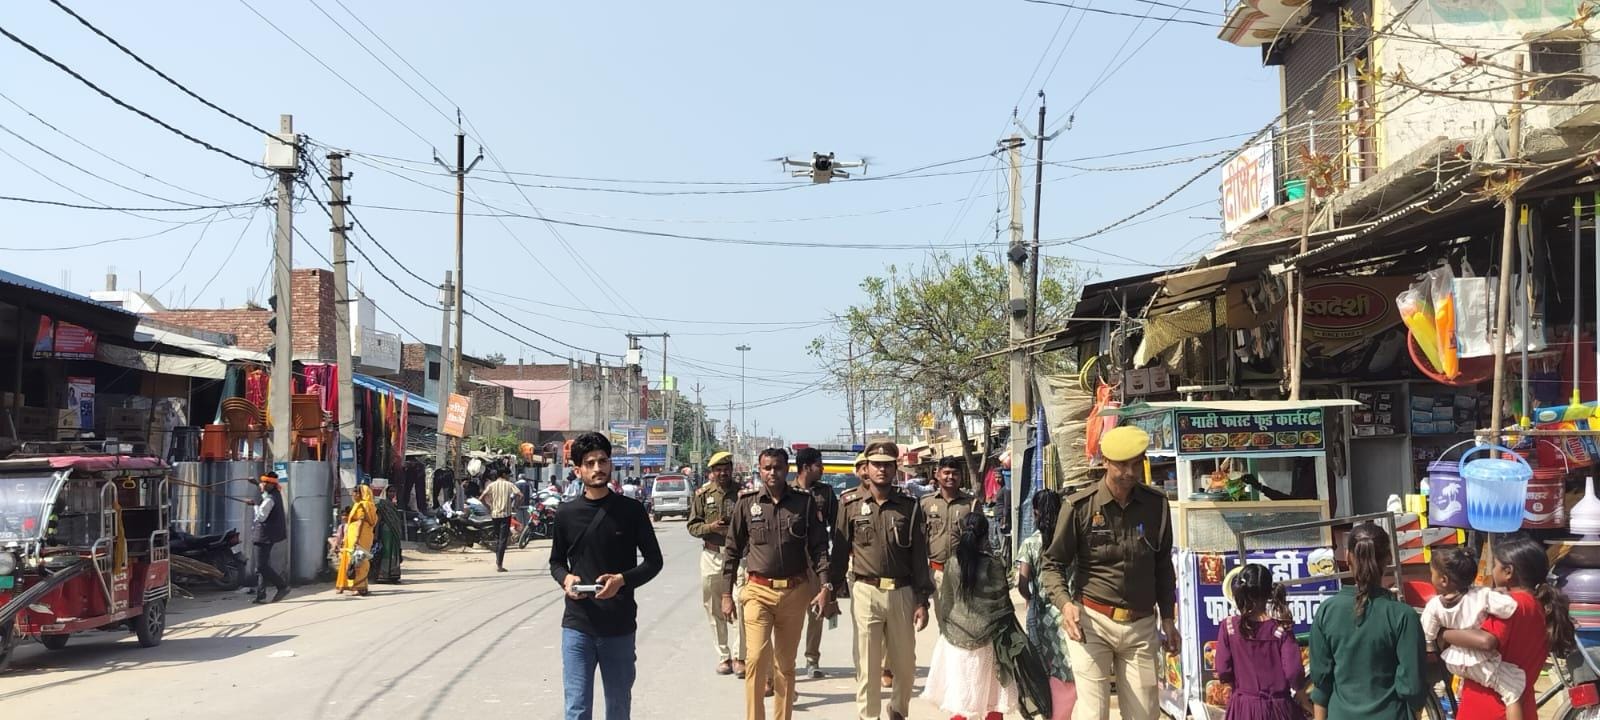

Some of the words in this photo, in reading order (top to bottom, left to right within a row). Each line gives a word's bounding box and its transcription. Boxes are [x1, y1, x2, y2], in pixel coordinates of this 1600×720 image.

[1224, 155, 1260, 222] दीक्षित
[1191, 414, 1218, 428] माही
[1221, 414, 1251, 428] फास्ट
[1252, 413, 1273, 431] फूड
[1276, 411, 1309, 427] कार्नर
